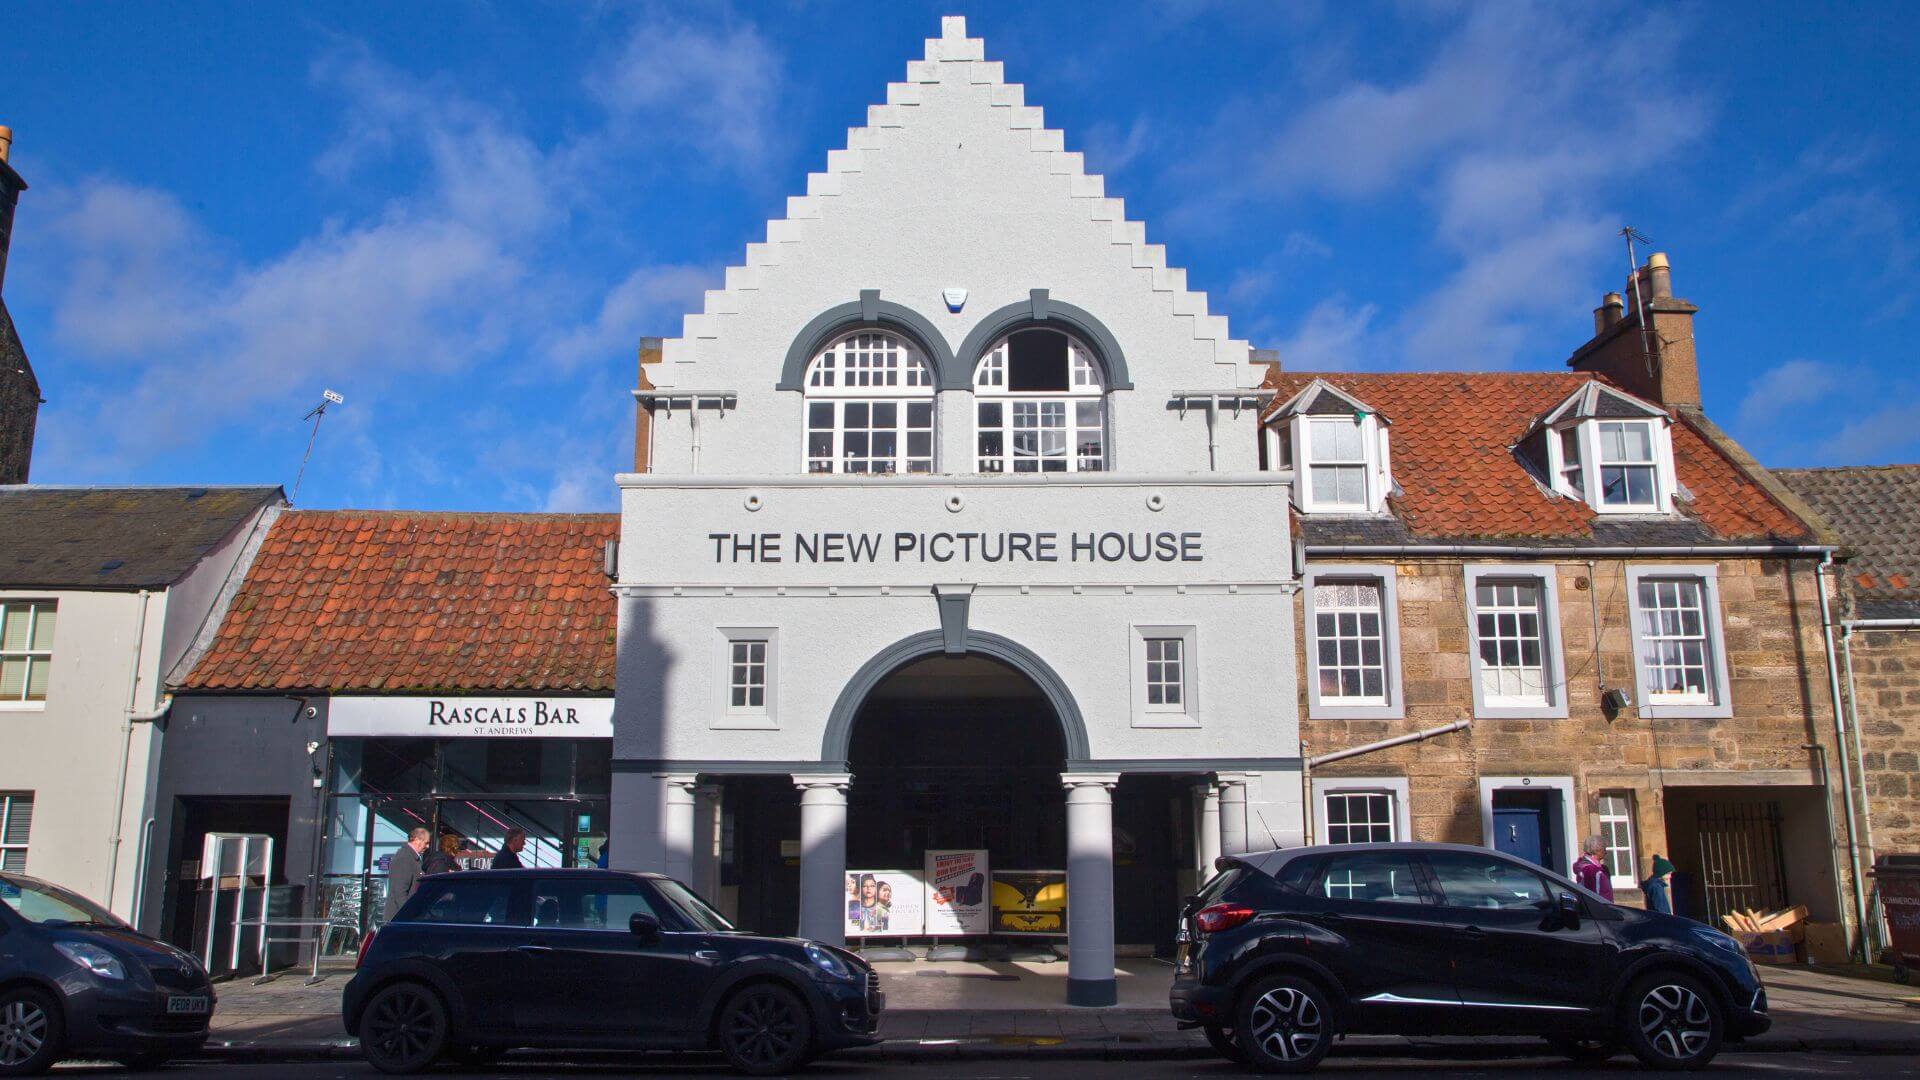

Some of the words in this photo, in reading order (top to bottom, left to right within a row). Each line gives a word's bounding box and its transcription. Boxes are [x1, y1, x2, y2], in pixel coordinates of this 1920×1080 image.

[709, 534, 781, 562] THE
[796, 534, 881, 562] NEW
[895, 533, 1057, 562] PICTURE
[1072, 533, 1203, 562] HOUSE
[429, 701, 526, 725] RASCALS
[535, 702, 579, 726] BAR
[487, 727, 533, 735] ANDREWS
